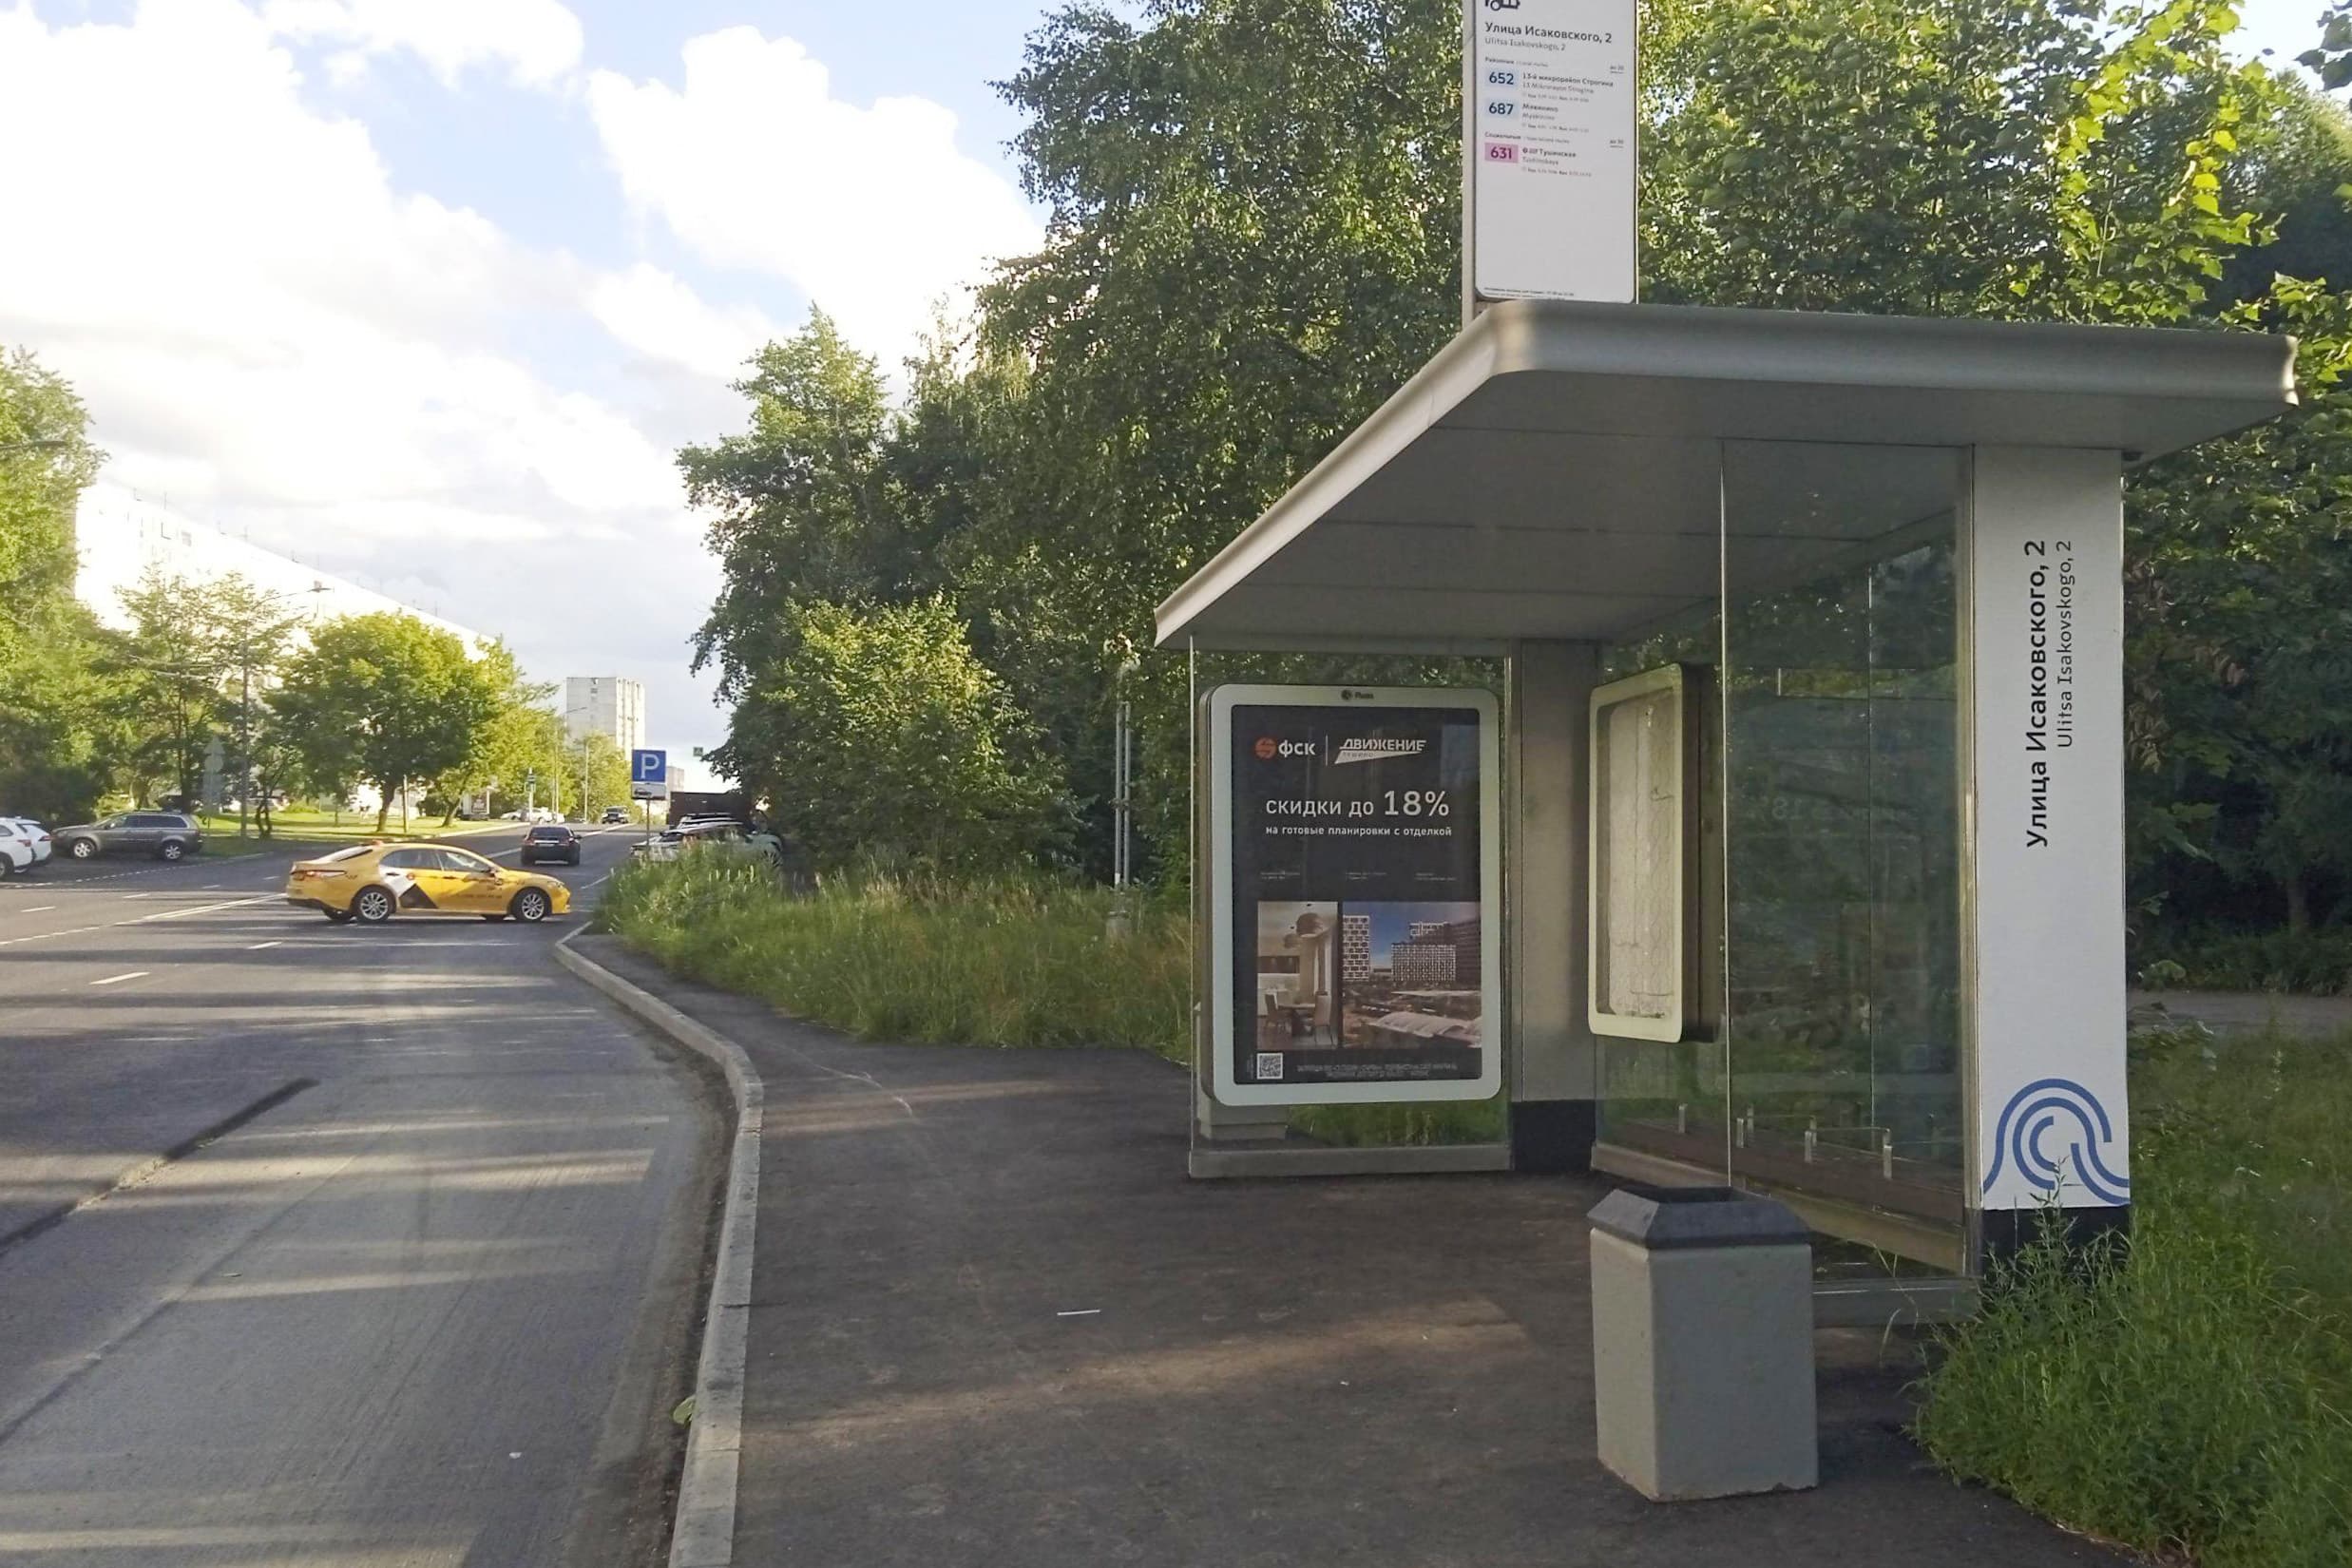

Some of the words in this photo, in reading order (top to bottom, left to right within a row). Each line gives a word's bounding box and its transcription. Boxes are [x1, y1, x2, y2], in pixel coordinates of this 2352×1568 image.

[1484, 21, 1522, 36] Улица
[1525, 25, 1602, 44] Исаковского,
[1605, 32, 1613, 44] 2
[1560, 43, 1567, 51] 2
[1488, 71, 1515, 86] 652
[1488, 102, 1515, 115] 687
[1490, 145, 1513, 161] 631
[2024, 540, 2045, 556] 2
[2056, 540, 2072, 551] 2
[2056, 557, 2075, 685] Isakovskogo,
[2025, 564, 2050, 752] Исаковского,
[2056, 691, 2073, 748] Ulitsa
[1339, 737, 1427, 752] ДВИЖЕНИЕ
[640, 753, 660, 779] P
[1348, 800, 1375, 818] до
[1384, 790, 1450, 817] 18%
[2026, 760, 2050, 848] Улица
[1265, 826, 1279, 835] на
[1281, 826, 1326, 835] готовые
[1328, 826, 1391, 837] планировки
[1394, 828, 1401, 836] с
[1403, 825, 1453, 837] отделкой
